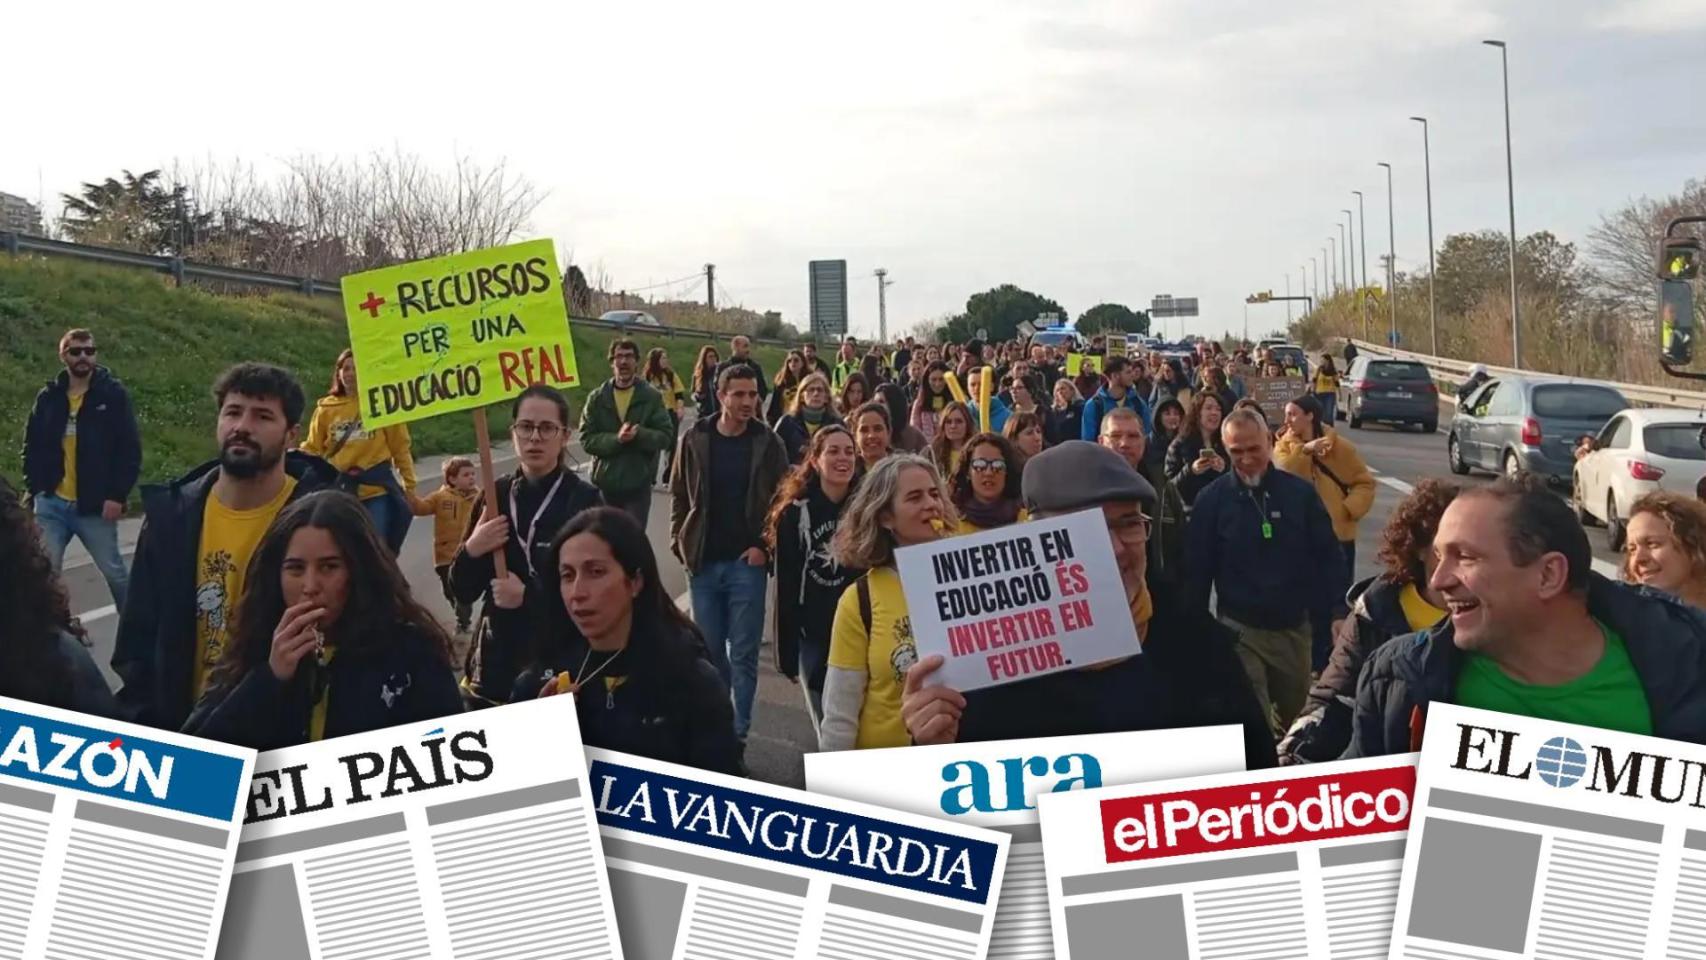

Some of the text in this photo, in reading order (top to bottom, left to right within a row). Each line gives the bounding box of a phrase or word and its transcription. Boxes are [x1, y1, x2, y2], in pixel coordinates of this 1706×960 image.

[397, 257, 550, 318] RECURSOS
[403, 313, 526, 358] PER UNA
[367, 344, 574, 418] EDUCACIÓ REAL
[931, 528, 1074, 584] INVERTIR EN
[935, 559, 1089, 621] EDUCACIÓ ÉS
[947, 600, 1093, 657] INVERTIR EN
[986, 641, 1072, 681] FUTUR.
